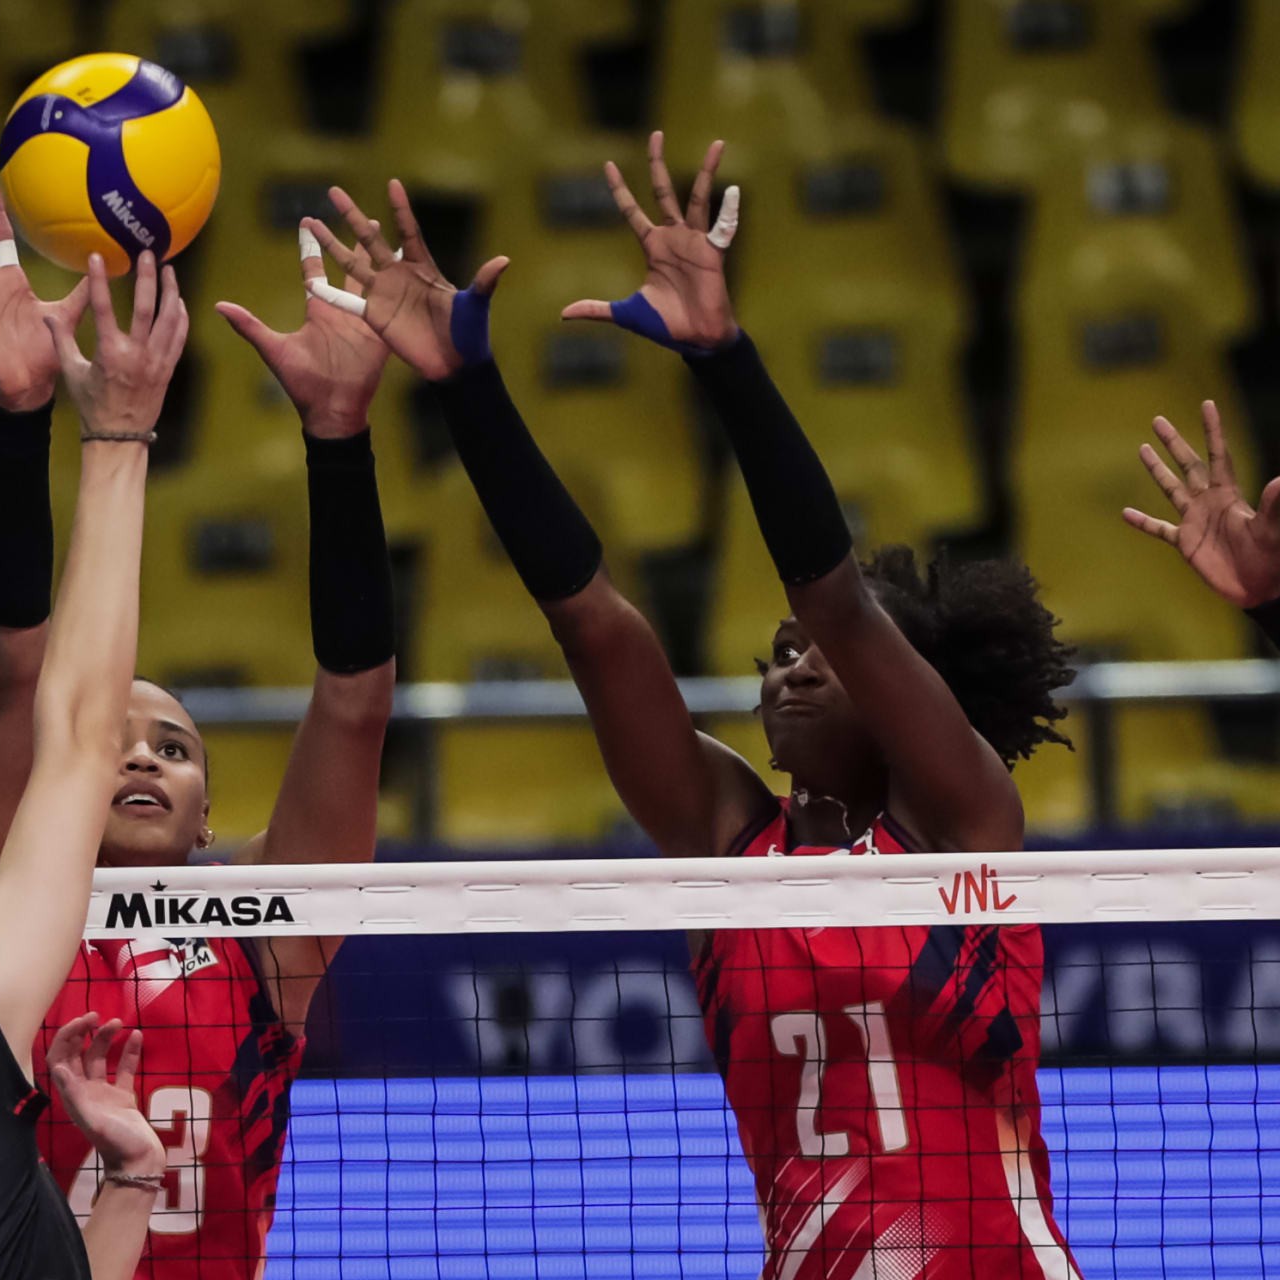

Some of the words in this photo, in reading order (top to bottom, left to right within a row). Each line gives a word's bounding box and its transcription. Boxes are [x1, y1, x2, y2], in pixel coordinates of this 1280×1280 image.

[105, 880, 296, 929] MIKASA
[938, 863, 1017, 915] VNL
[769, 1000, 909, 1159] 21
